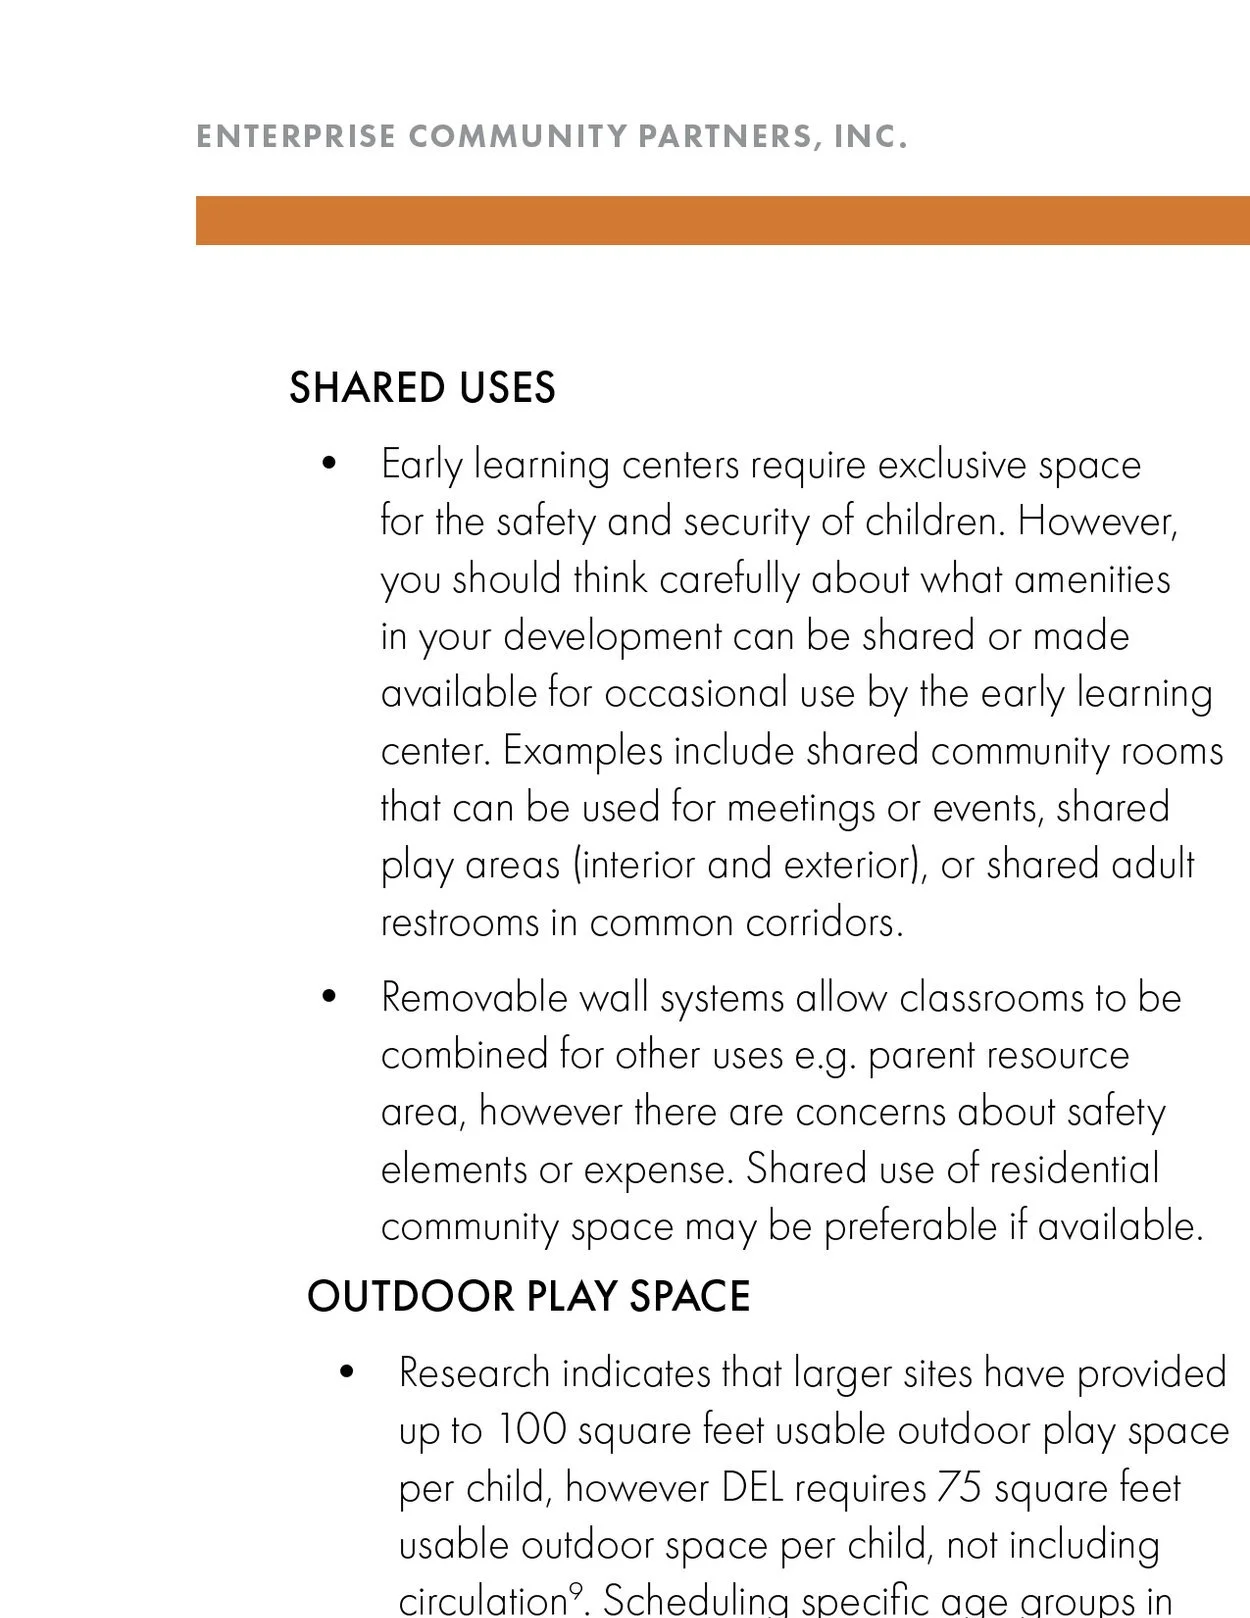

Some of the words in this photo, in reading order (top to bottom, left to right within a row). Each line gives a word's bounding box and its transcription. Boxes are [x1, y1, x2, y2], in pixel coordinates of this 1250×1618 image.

[197, 124, 394, 148] ENTERPRISE
[409, 124, 628, 148] COMMUNITY
[639, 124, 822, 152] PARTNERS,
[835, 124, 907, 149] INC.
[289, 369, 445, 404] SHARED
[461, 369, 556, 404] USES
[383, 444, 464, 489] Early
[475, 444, 609, 489] learning
[622, 451, 739, 480] centers
[752, 450, 866, 489] require
[878, 444, 1027, 480] exclusive
[1039, 457, 1141, 489] space
[380, 500, 425, 536] for
[435, 501, 485, 536] the
[496, 500, 597, 546] safety
[608, 501, 671, 536] and
[684, 507, 811, 546] security
[821, 500, 855, 536] of
[865, 501, 1005, 536] children.
[1019, 503, 1177, 542] However,
[381, 622, 406, 650] in
[418, 628, 492, 661] your
[504, 615, 723, 661] development
[733, 628, 794, 651] can
[808, 615, 850, 651] be
[862, 615, 974, 651] shared
[988, 628, 1023, 651] or
[1034, 615, 1130, 651] made
[381, 737, 490, 766] center.
[505, 730, 663, 776] Examples
[674, 730, 795, 766] include
[806, 730, 918, 766] shared
[931, 736, 1111, 776] community
[1122, 743, 1224, 766] rooms
[382, 909, 539, 937] restrooms
[551, 908, 577, 936] in
[590, 914, 733, 937] common
[746, 902, 903, 937] corridors.
[381, 1104, 466, 1132] area,
[480, 1091, 624, 1127] however
[634, 1091, 717, 1127] there
[729, 1104, 784, 1127] are
[796, 1104, 946, 1127] concerns
[958, 1091, 1056, 1127] about
[1067, 1090, 1167, 1136] safety
[307, 1278, 515, 1313] OUTDOOR
[528, 1278, 619, 1312] PLAY
[629, 1278, 750, 1313] SPACE
[401, 1353, 549, 1388] Research
[563, 1353, 711, 1388] indicates
[721, 1353, 783, 1388] that
[795, 1353, 893, 1398] larger
[903, 1359, 973, 1388] sites
[985, 1353, 1065, 1388] have
[1078, 1353, 1226, 1398] provided
[400, 1480, 455, 1513] per
[466, 1467, 552, 1509] child,
[566, 1467, 710, 1503] however
[723, 1469, 784, 1502] DEL
[796, 1473, 927, 1513] requires
[937, 1469, 981, 1503] 75
[994, 1480, 1108, 1513] square
[1119, 1466, 1182, 1503] feet
